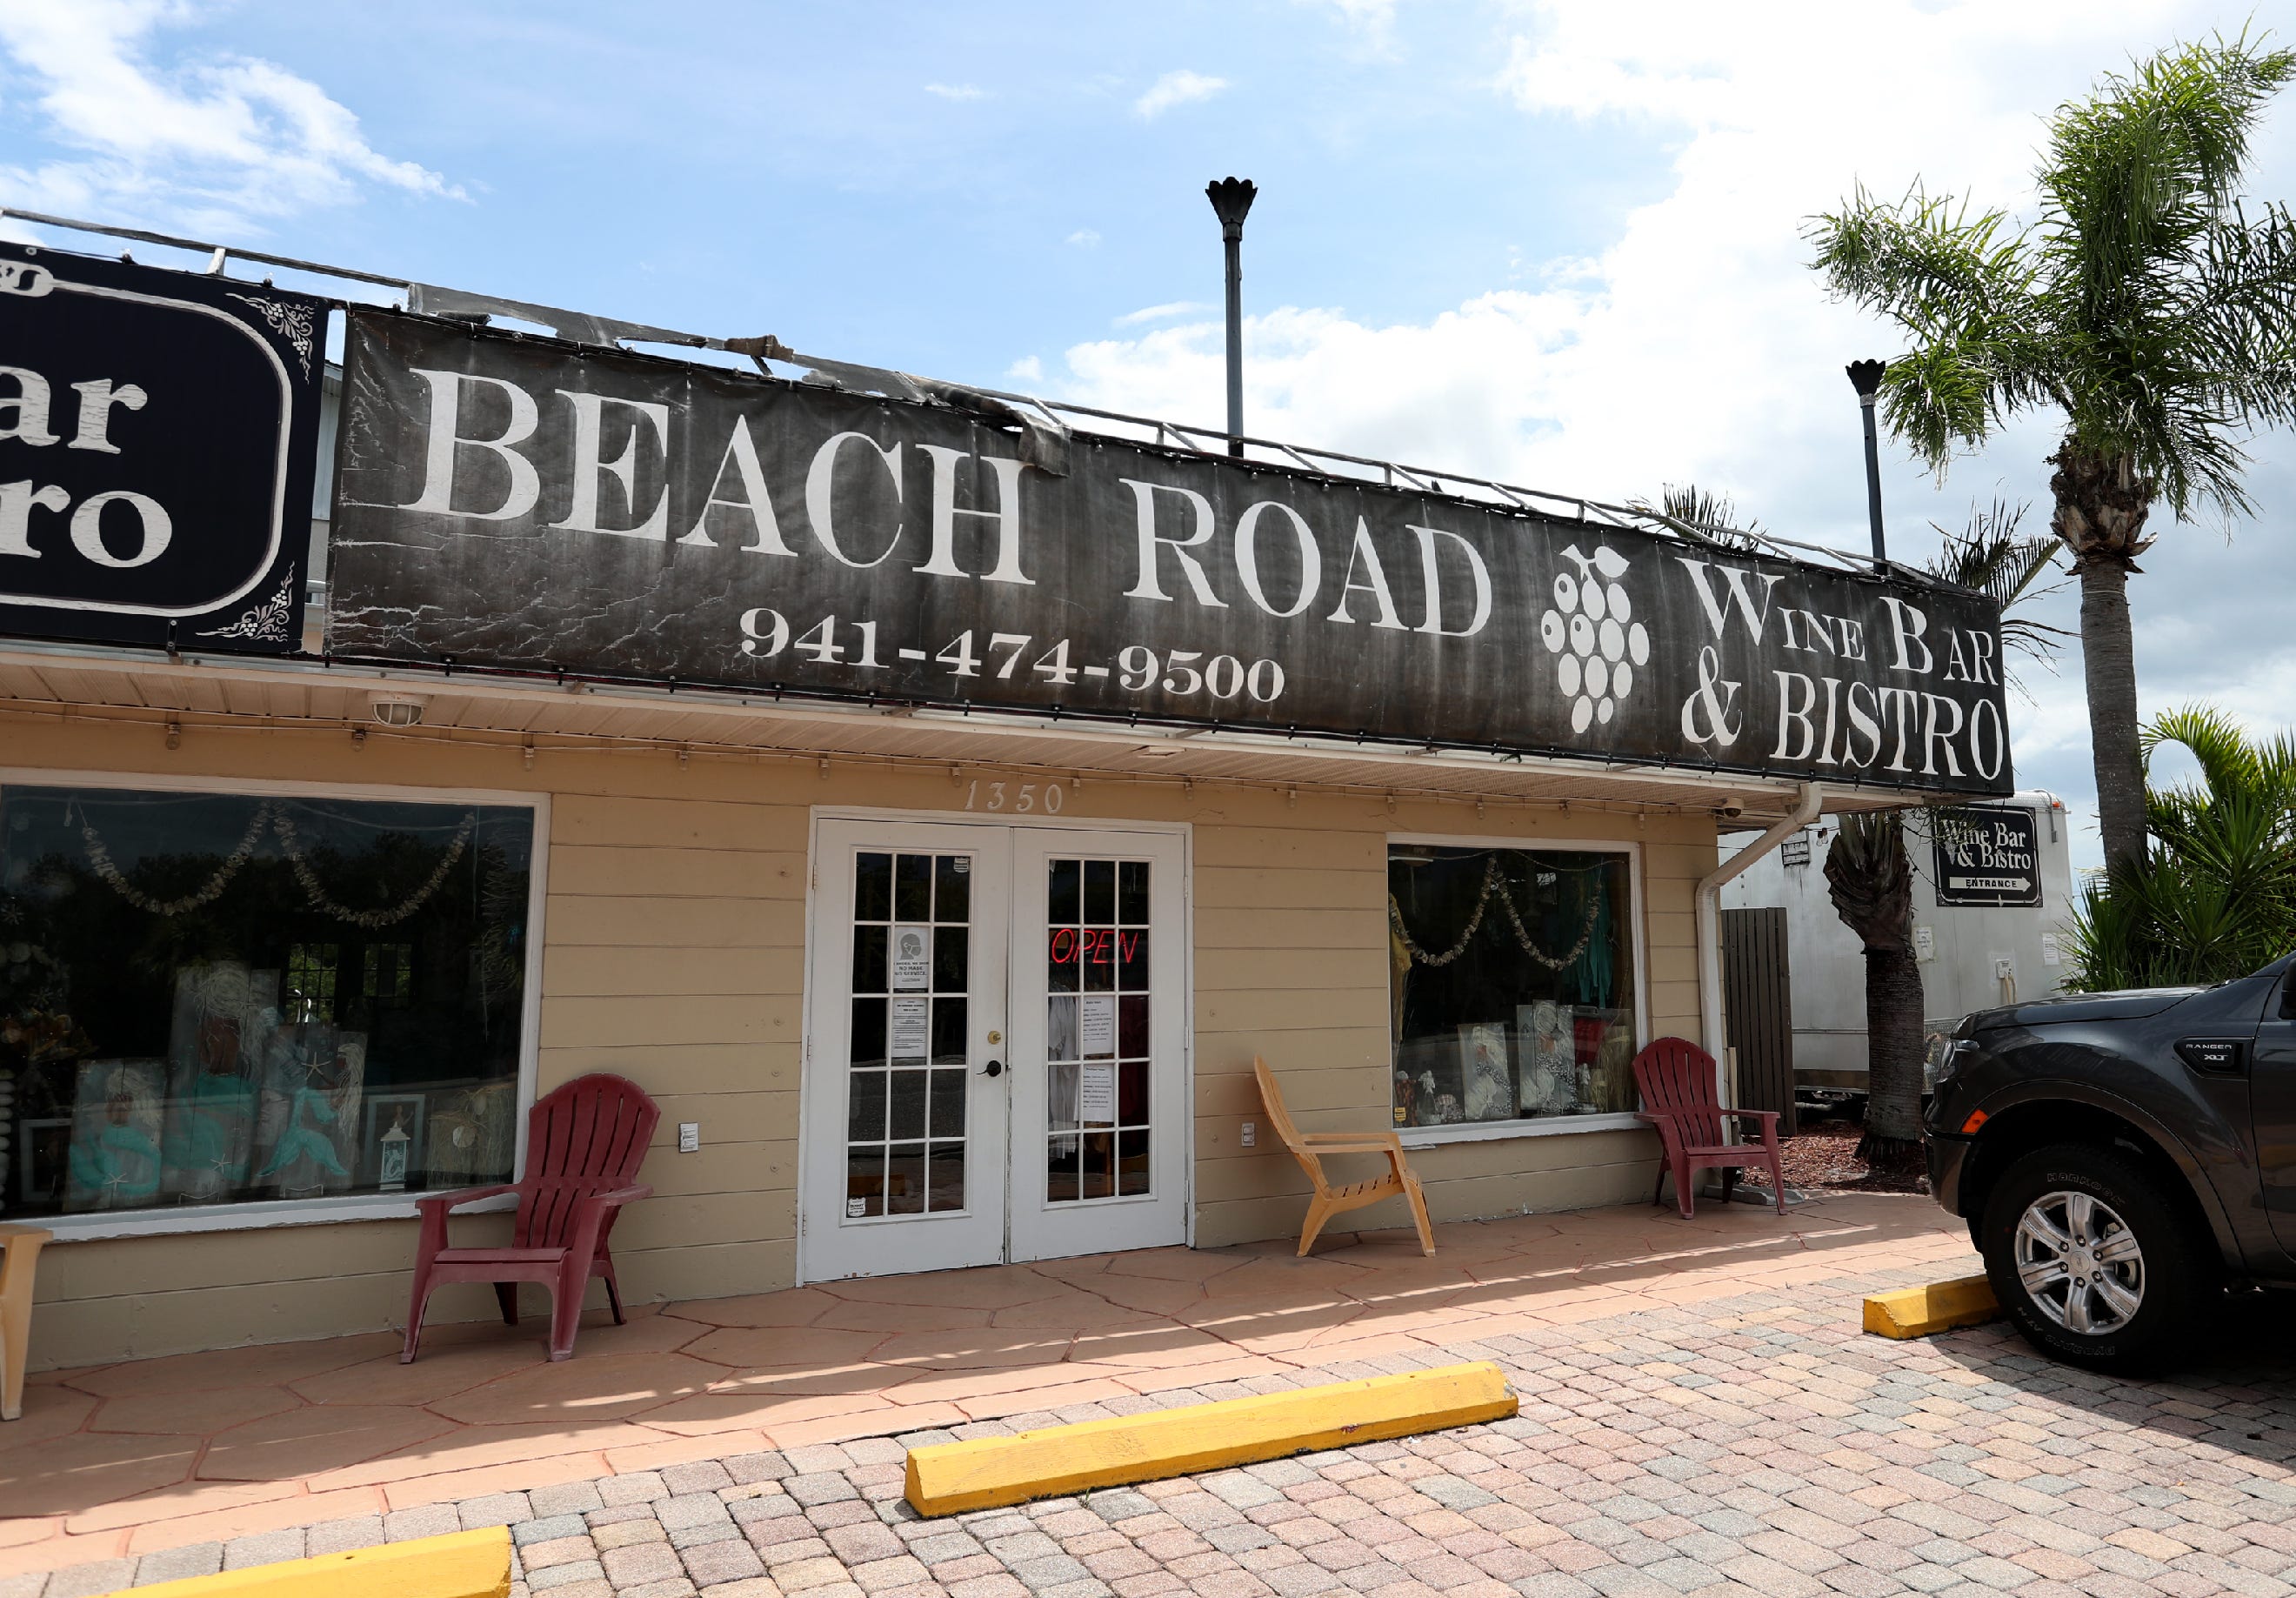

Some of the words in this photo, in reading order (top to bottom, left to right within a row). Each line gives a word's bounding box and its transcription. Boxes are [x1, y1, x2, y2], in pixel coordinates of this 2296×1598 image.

[397, 367, 1036, 585] BEACH
[1118, 478, 1492, 638] ROAD
[739, 607, 1285, 703] 941-474-9500
[1681, 645, 1743, 746] &
[1769, 670, 2004, 781] BISTRO
[964, 779, 1063, 814] 1350
[1994, 822, 2026, 848] Bar
[1957, 843, 1976, 868] &
[1979, 844, 2032, 870] Bistro
[1966, 879, 2018, 888] ENTRANCE
[1051, 928, 1138, 964] OPEN
